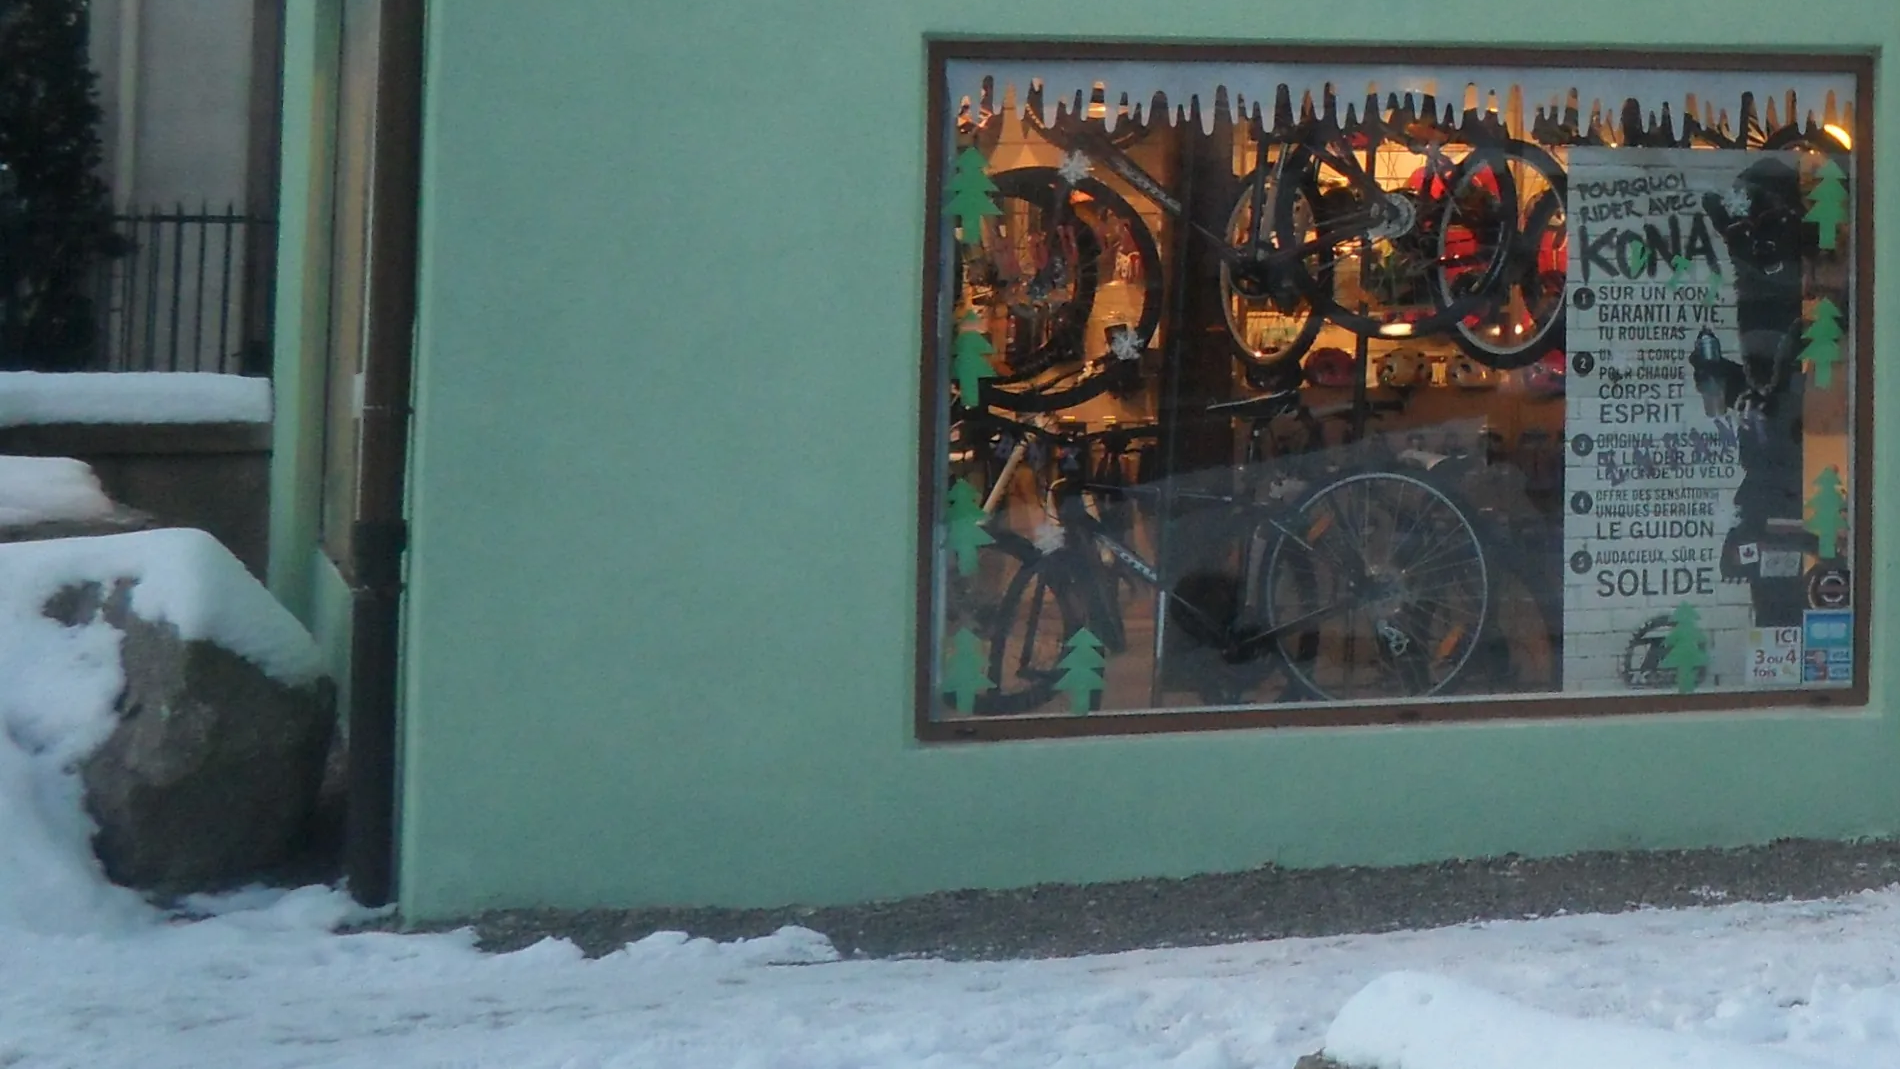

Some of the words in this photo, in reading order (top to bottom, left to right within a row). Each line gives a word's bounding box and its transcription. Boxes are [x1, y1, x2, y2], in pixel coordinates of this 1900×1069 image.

[1577, 172, 1686, 201] POURQUOI
[1579, 199, 1643, 224] RIDER
[1649, 192, 1696, 216] AVEC
[1578, 212, 1722, 286] KONA
[1599, 286, 1633, 301] SUR
[1641, 286, 1666, 301] UN
[1599, 304, 1670, 323] GARANTI
[1693, 305, 1724, 324] VIE,
[1599, 326, 1614, 341] TU
[1619, 326, 1686, 341] ROULERAS
[1637, 367, 1685, 380] CHAQUE
[1599, 384, 1661, 400] CORPS
[1668, 384, 1685, 399] ET
[1599, 404, 1685, 424] ESPRIT
[1675, 467, 1694, 479] DU
[1700, 465, 1735, 478] VÉLO
[1596, 490, 1628, 501] OFFRE
[1633, 489, 1651, 500] DES
[1596, 504, 1649, 518] UNIQUES
[1597, 522, 1621, 540] LE
[1629, 520, 1714, 539] GUIDON
[1596, 549, 1667, 565] AUDACIEUX,
[1672, 546, 1696, 562] SÛR
[1701, 548, 1713, 561] ET
[1596, 567, 1714, 597] SOLIDE
[1775, 630, 1798, 643] ICI
[1755, 649, 1765, 665] 3
[1767, 656, 1783, 664] ou
[1785, 649, 1797, 664] 4
